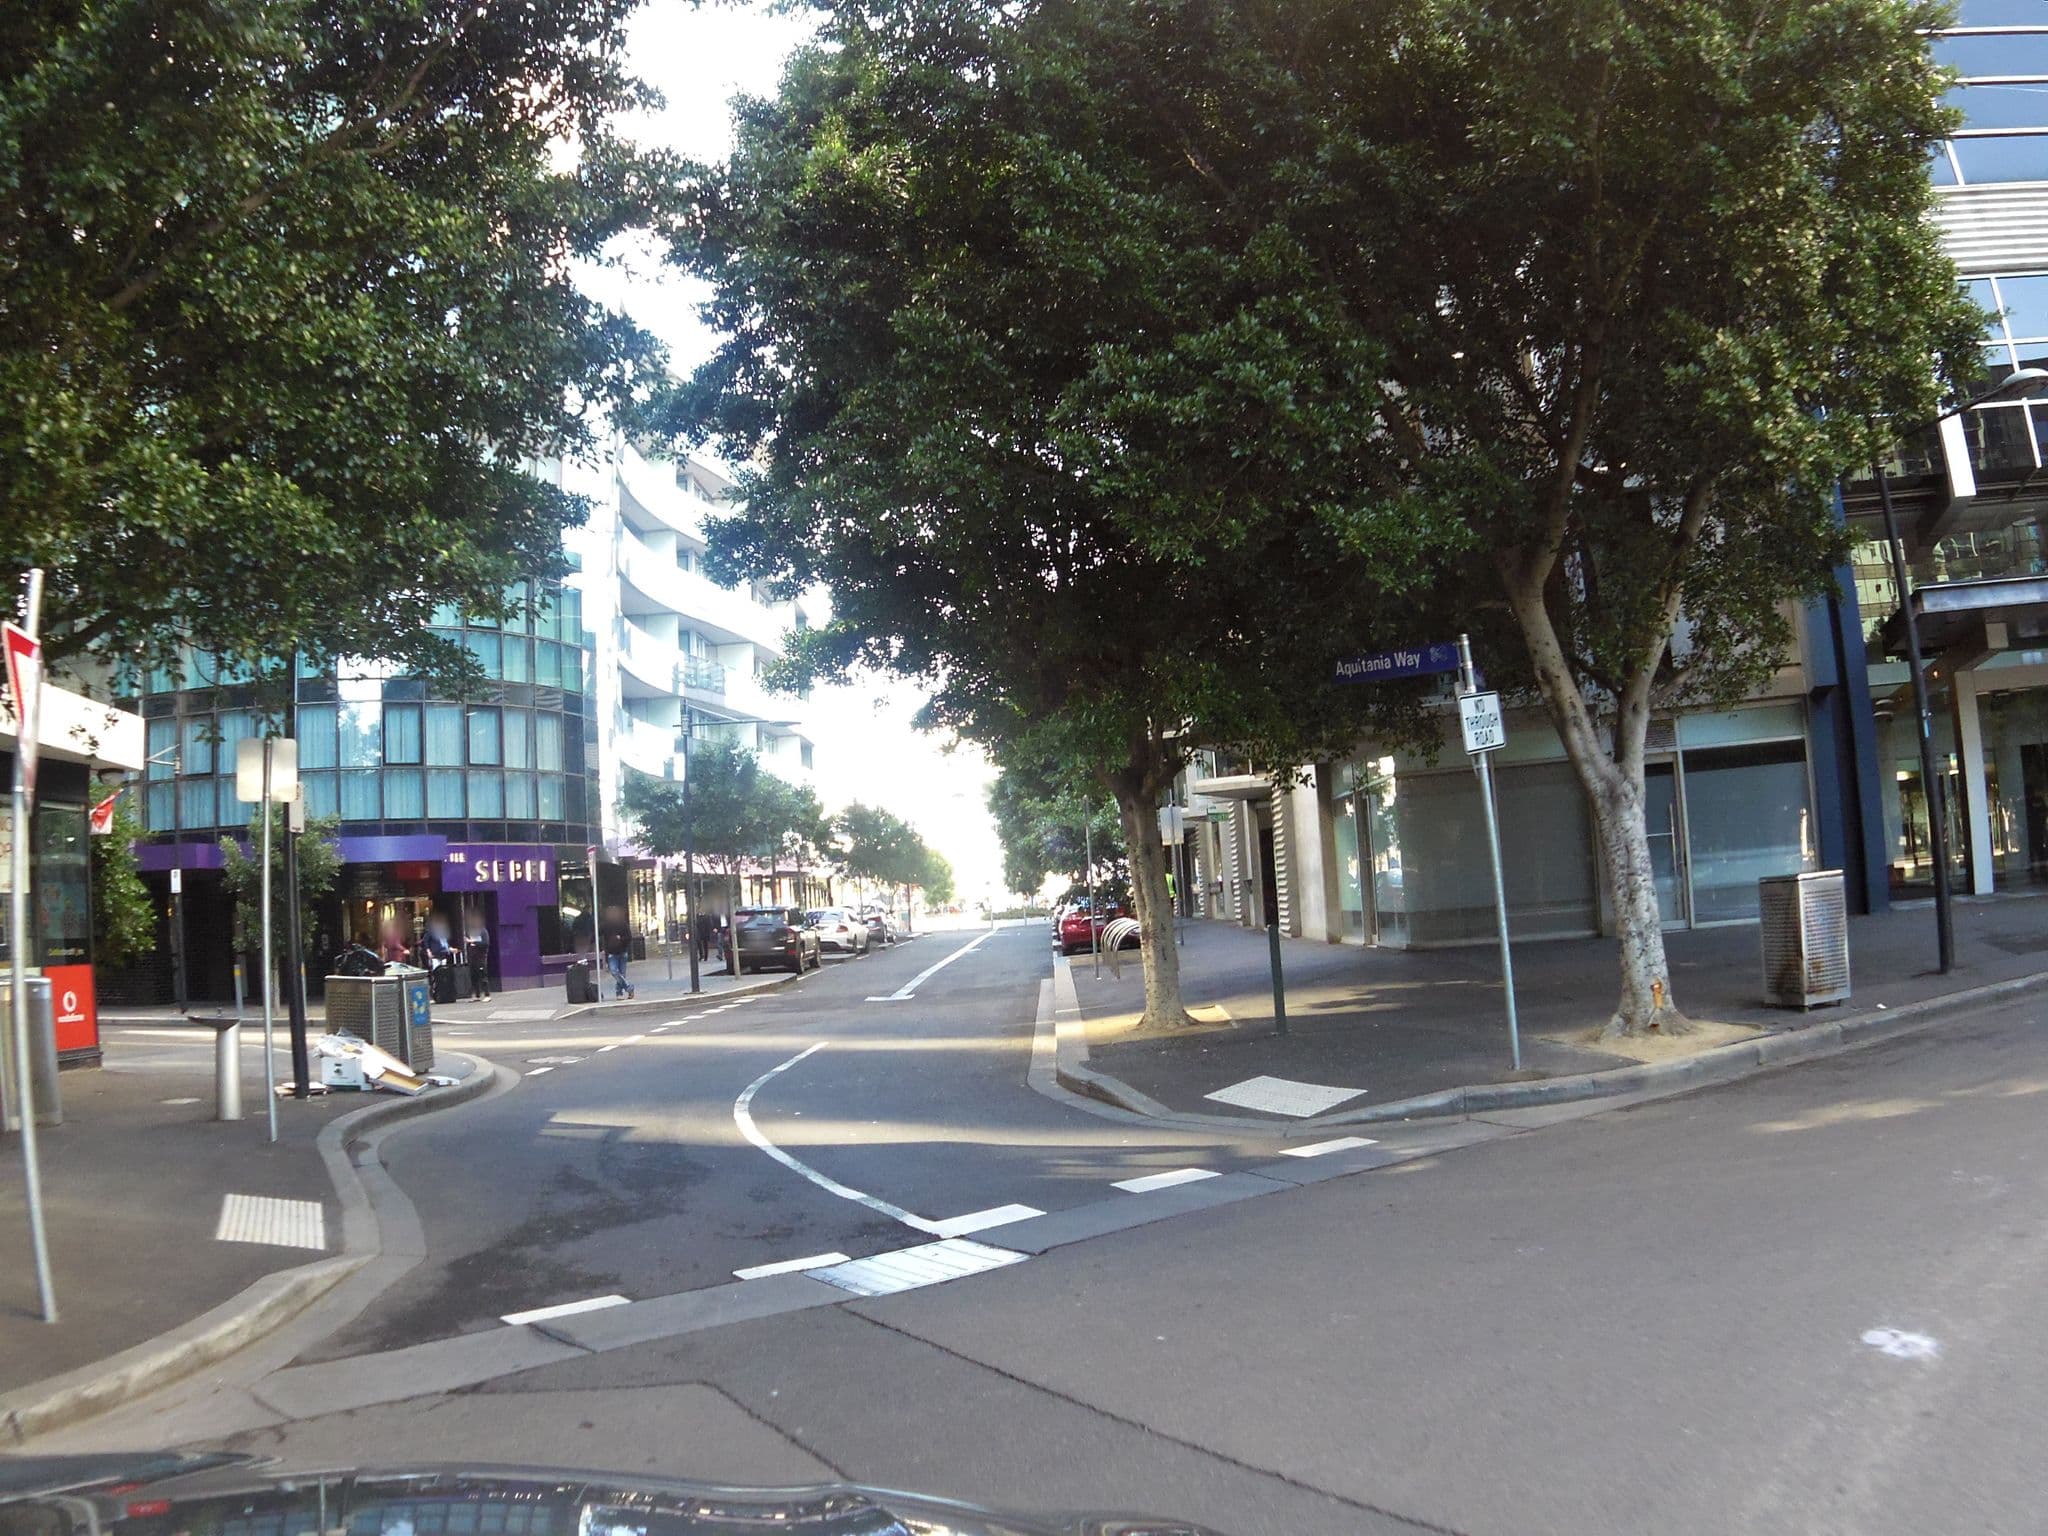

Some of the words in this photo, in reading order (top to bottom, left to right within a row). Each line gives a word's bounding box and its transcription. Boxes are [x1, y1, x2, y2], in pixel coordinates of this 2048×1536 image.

[1335, 655, 1392, 678] Aquitania
[1394, 651, 1420, 669] Way
[1474, 699, 1485, 713] NO
[1465, 713, 1499, 731] THROUGH
[1474, 729, 1495, 746] ROAD
[444, 852, 466, 863] HE
[475, 860, 550, 882] SEBEL
